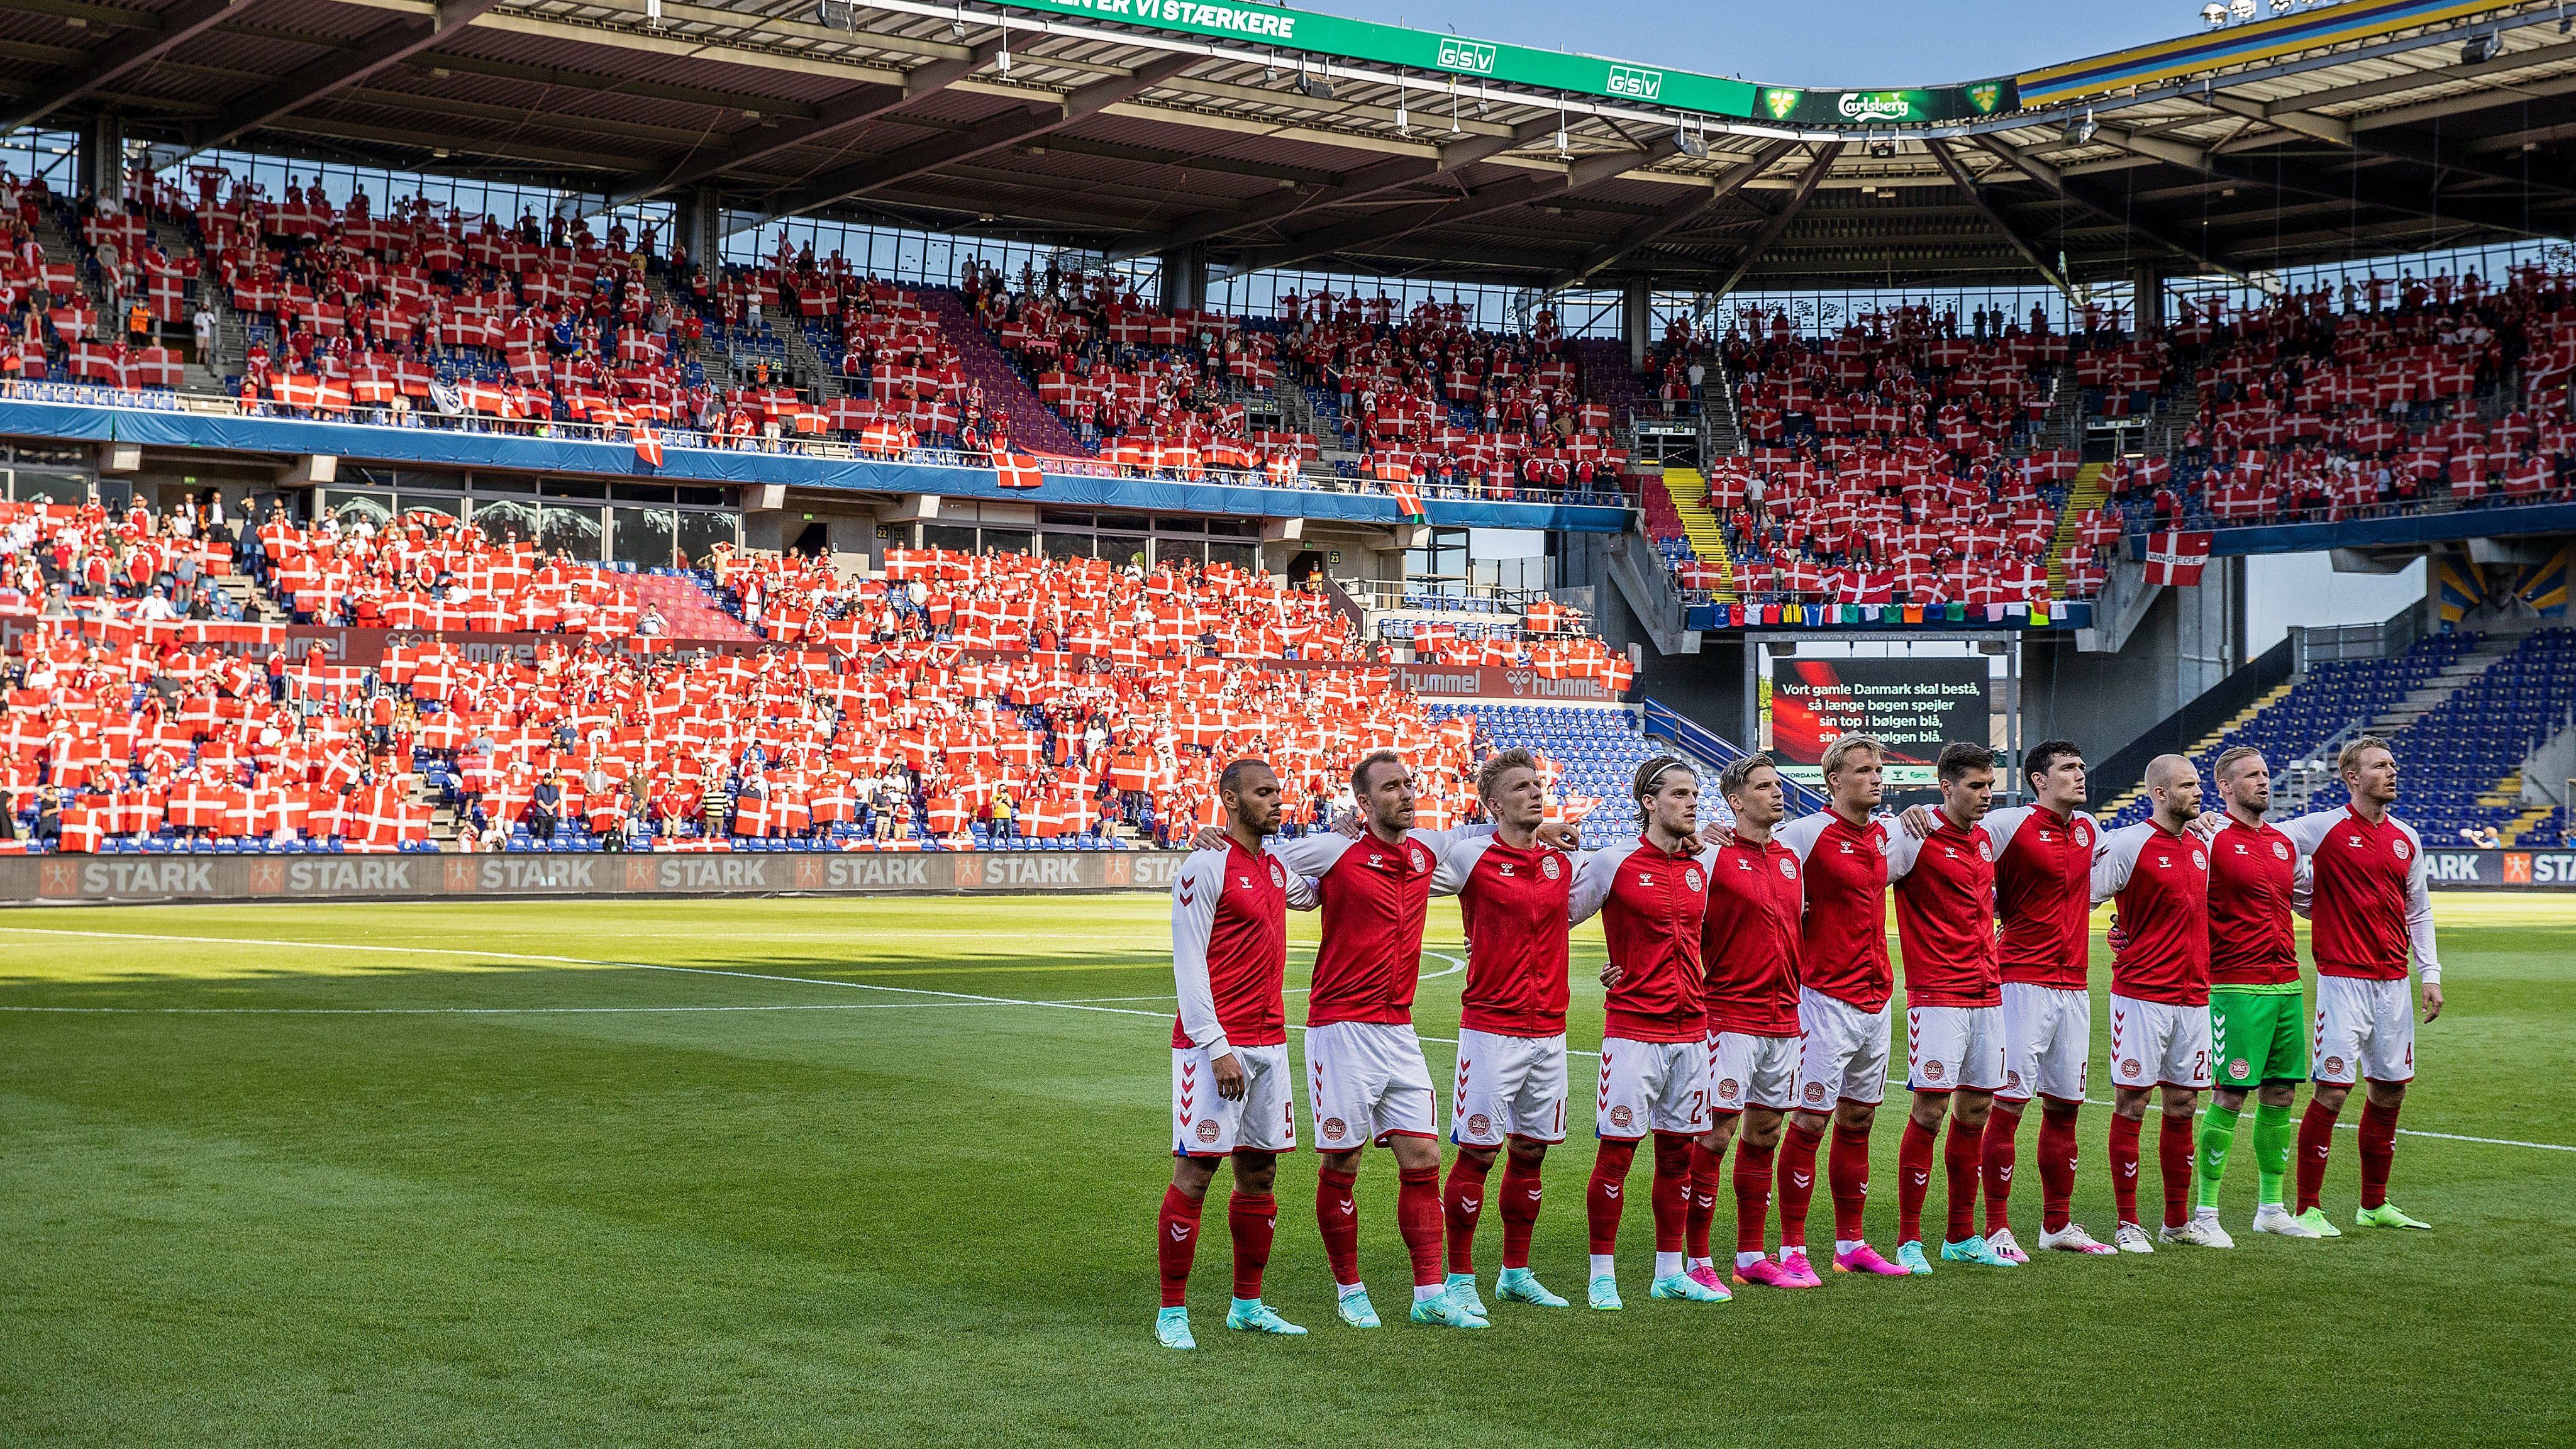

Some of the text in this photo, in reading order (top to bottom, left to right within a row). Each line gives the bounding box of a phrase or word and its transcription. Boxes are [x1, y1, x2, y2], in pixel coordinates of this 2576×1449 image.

[1133, 0, 1160, 18] VI
[1162, 0, 1296, 38] STÆRKERE
[1441, 48, 1492, 70] GSV
[1610, 75, 1658, 96] GSV
[1838, 92, 1909, 122] Carlsberg
[877, 530, 887, 538] 22
[1401, 667, 1480, 693] hummel
[1782, 682, 1980, 696] Vort gamle Danmark skal bestå,
[1807, 698, 1955, 713] så længe bøgen spejler
[1819, 714, 1943, 728] sin top i bølgen blå,
[1819, 731, 1838, 742] sin
[1919, 730, 1943, 742] blå.
[83, 862, 213, 893] STARK
[289, 860, 411, 891] STARK
[480, 859, 595, 888] STARK
[660, 858, 767, 887] STARK
[828, 858, 928, 886] STARK
[985, 857, 1080, 884] STARK
[1135, 857, 1182, 882] STA
[2424, 854, 2480, 880] ARK
[2405, 1041, 2412, 1070] 4
[1472, 1121, 1486, 1129] DBU
[1614, 1112, 1628, 1120] DBU
